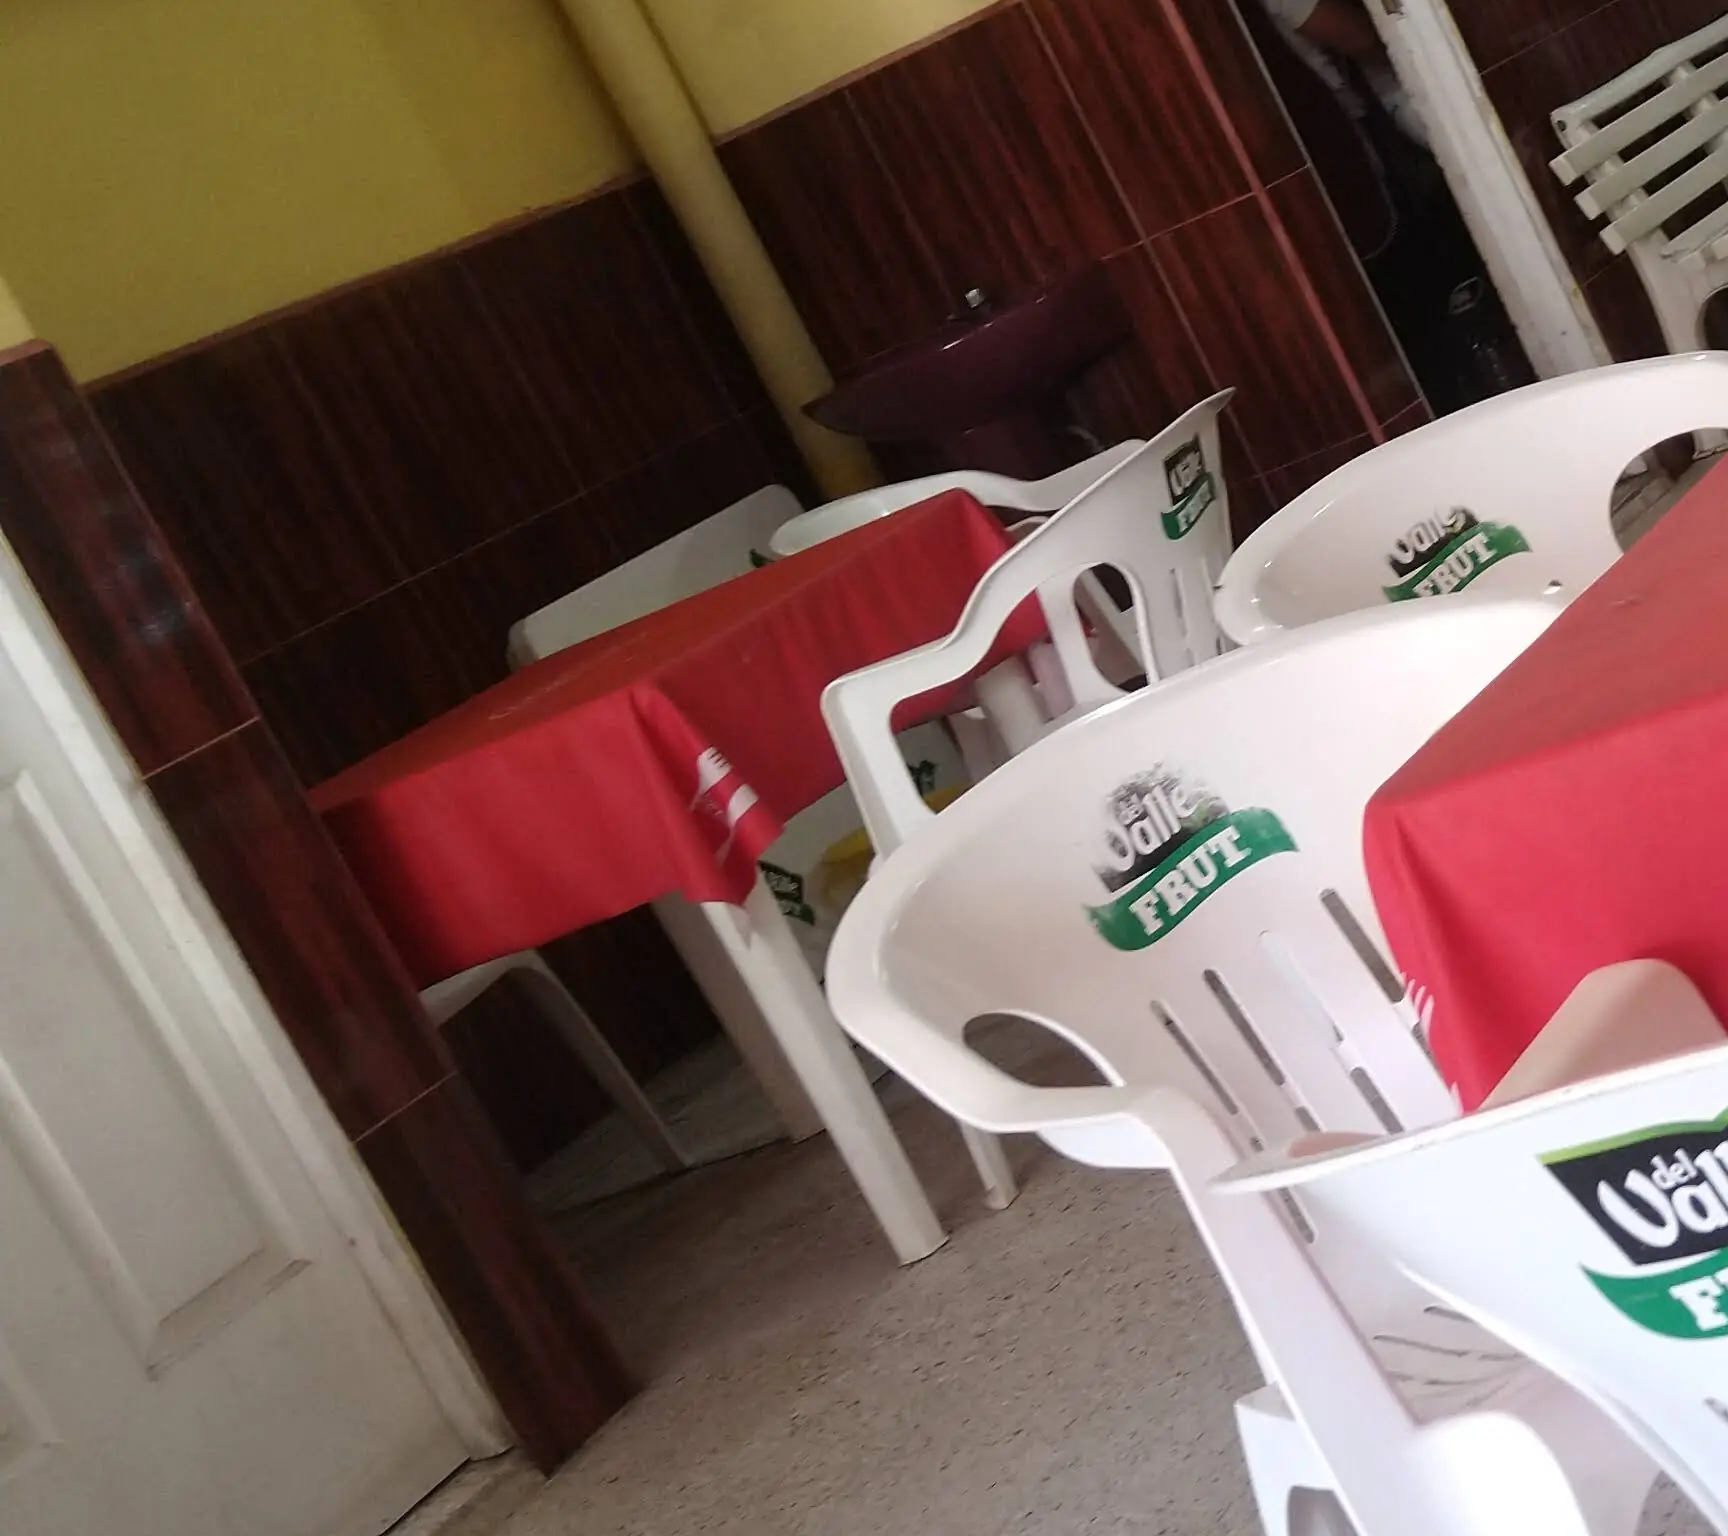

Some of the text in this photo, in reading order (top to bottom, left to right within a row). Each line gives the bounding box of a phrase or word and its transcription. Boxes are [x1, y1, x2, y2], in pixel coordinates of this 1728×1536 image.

[1412, 531, 1498, 597] FRUT
[1128, 825, 1252, 936] FRUT
[1651, 1147, 1699, 1190] del
